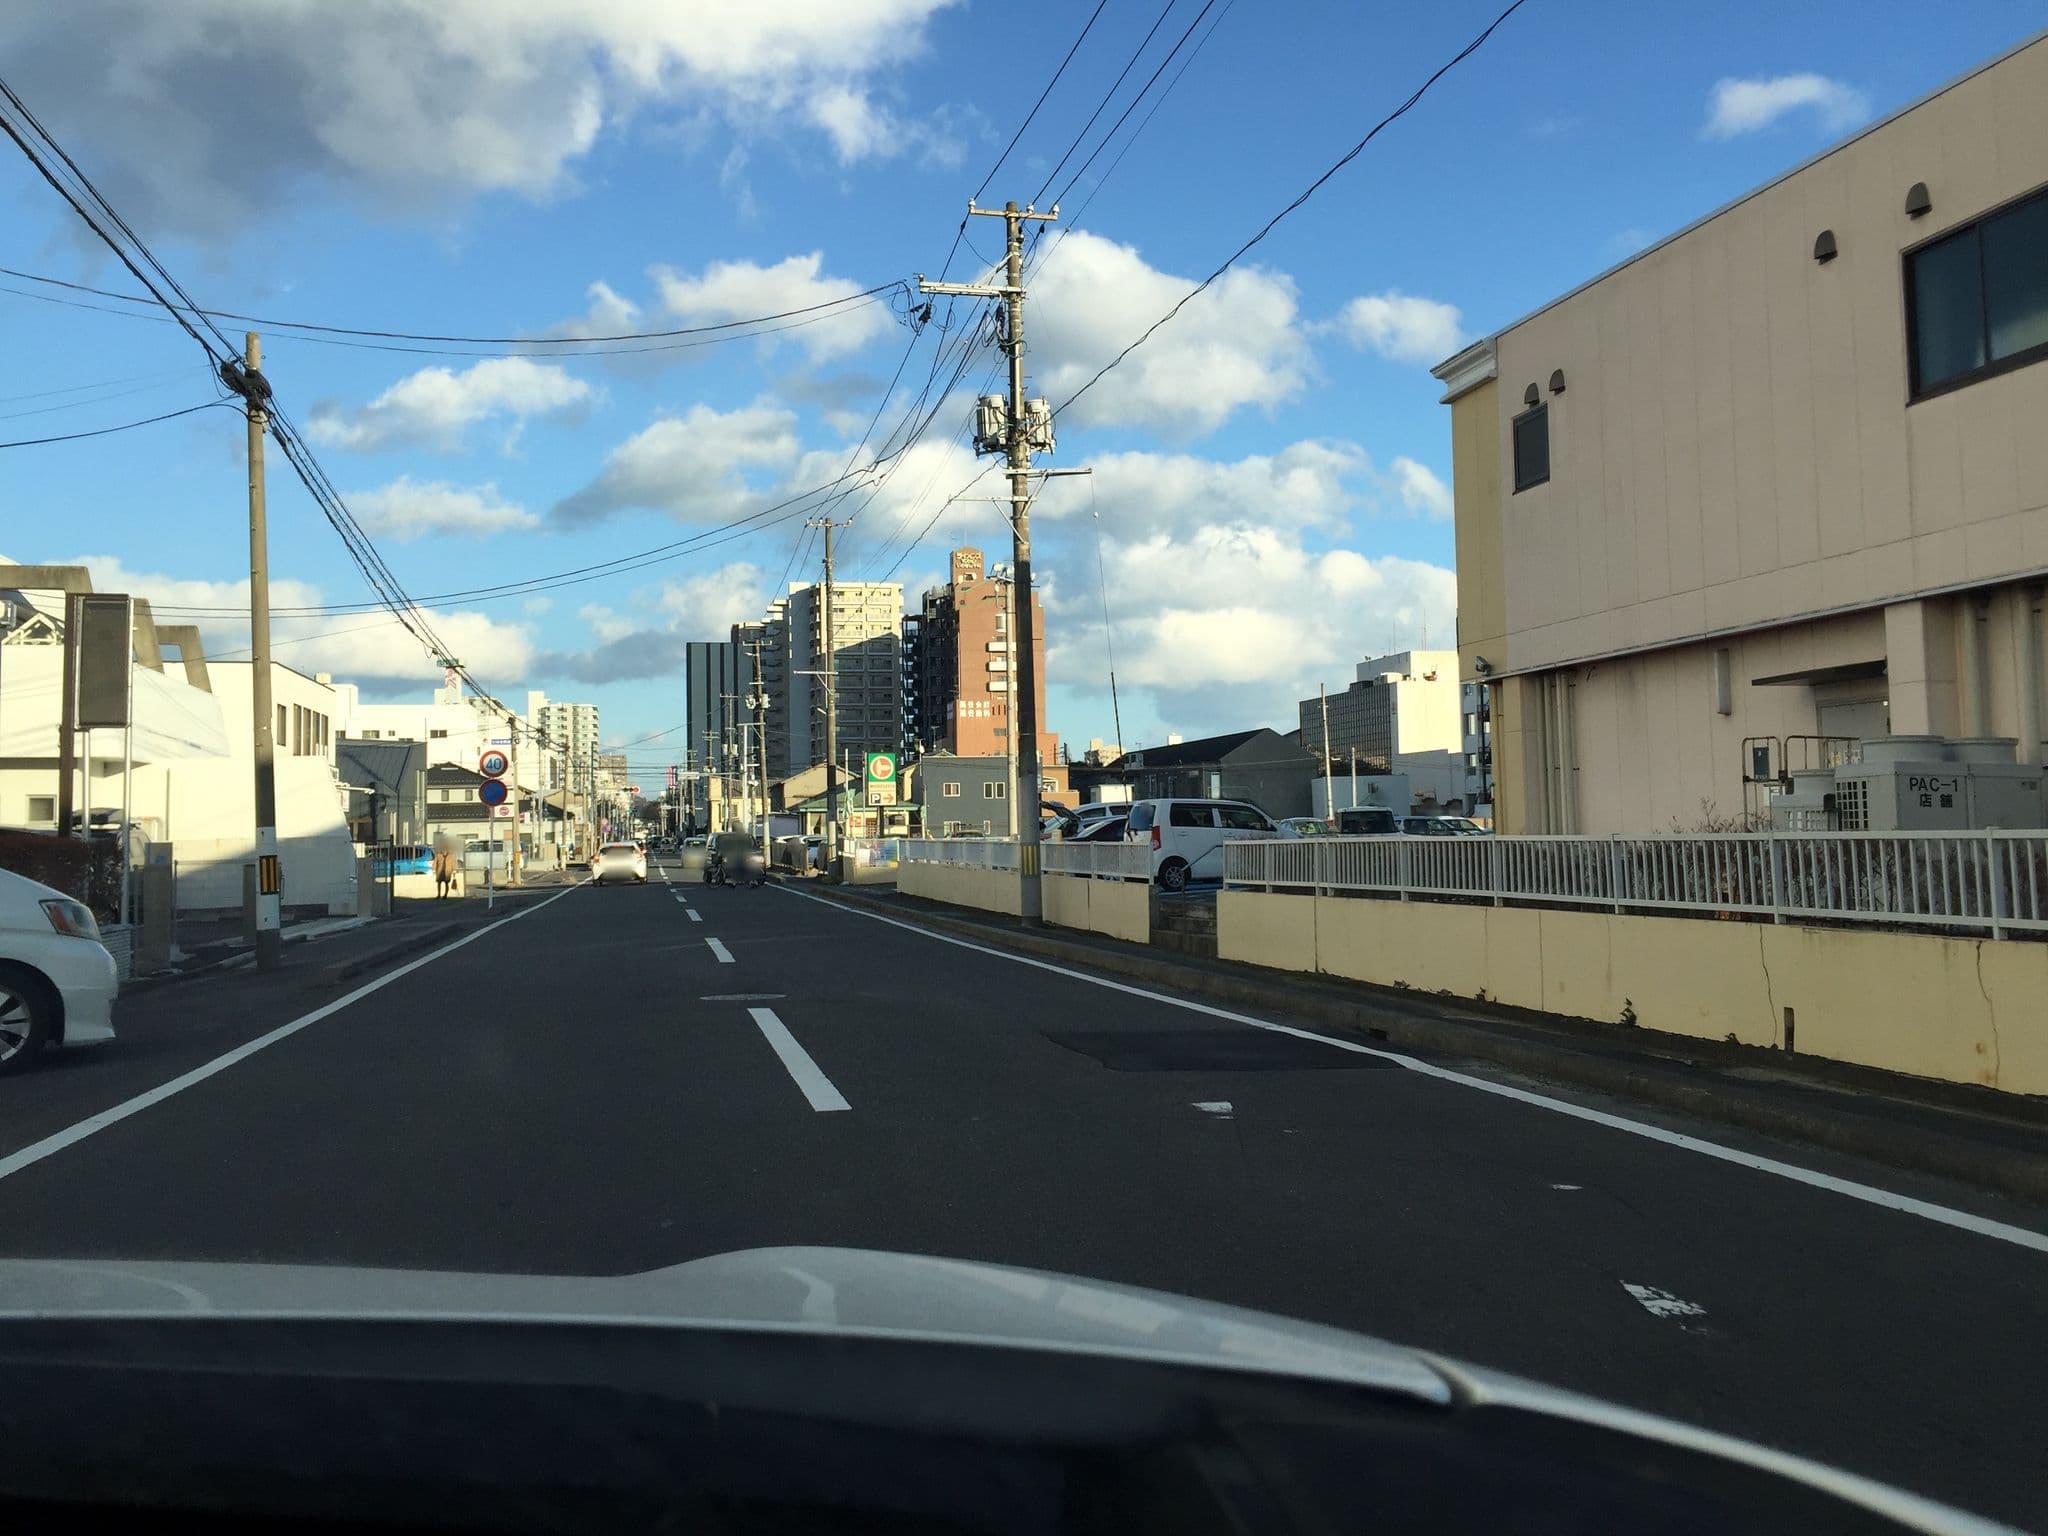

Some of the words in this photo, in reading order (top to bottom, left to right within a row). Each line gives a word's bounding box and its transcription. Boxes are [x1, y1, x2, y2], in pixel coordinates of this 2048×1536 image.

[486, 757, 502, 770] 40
[1909, 777, 1958, 792] PAC-1
[870, 793, 880, 804] P
